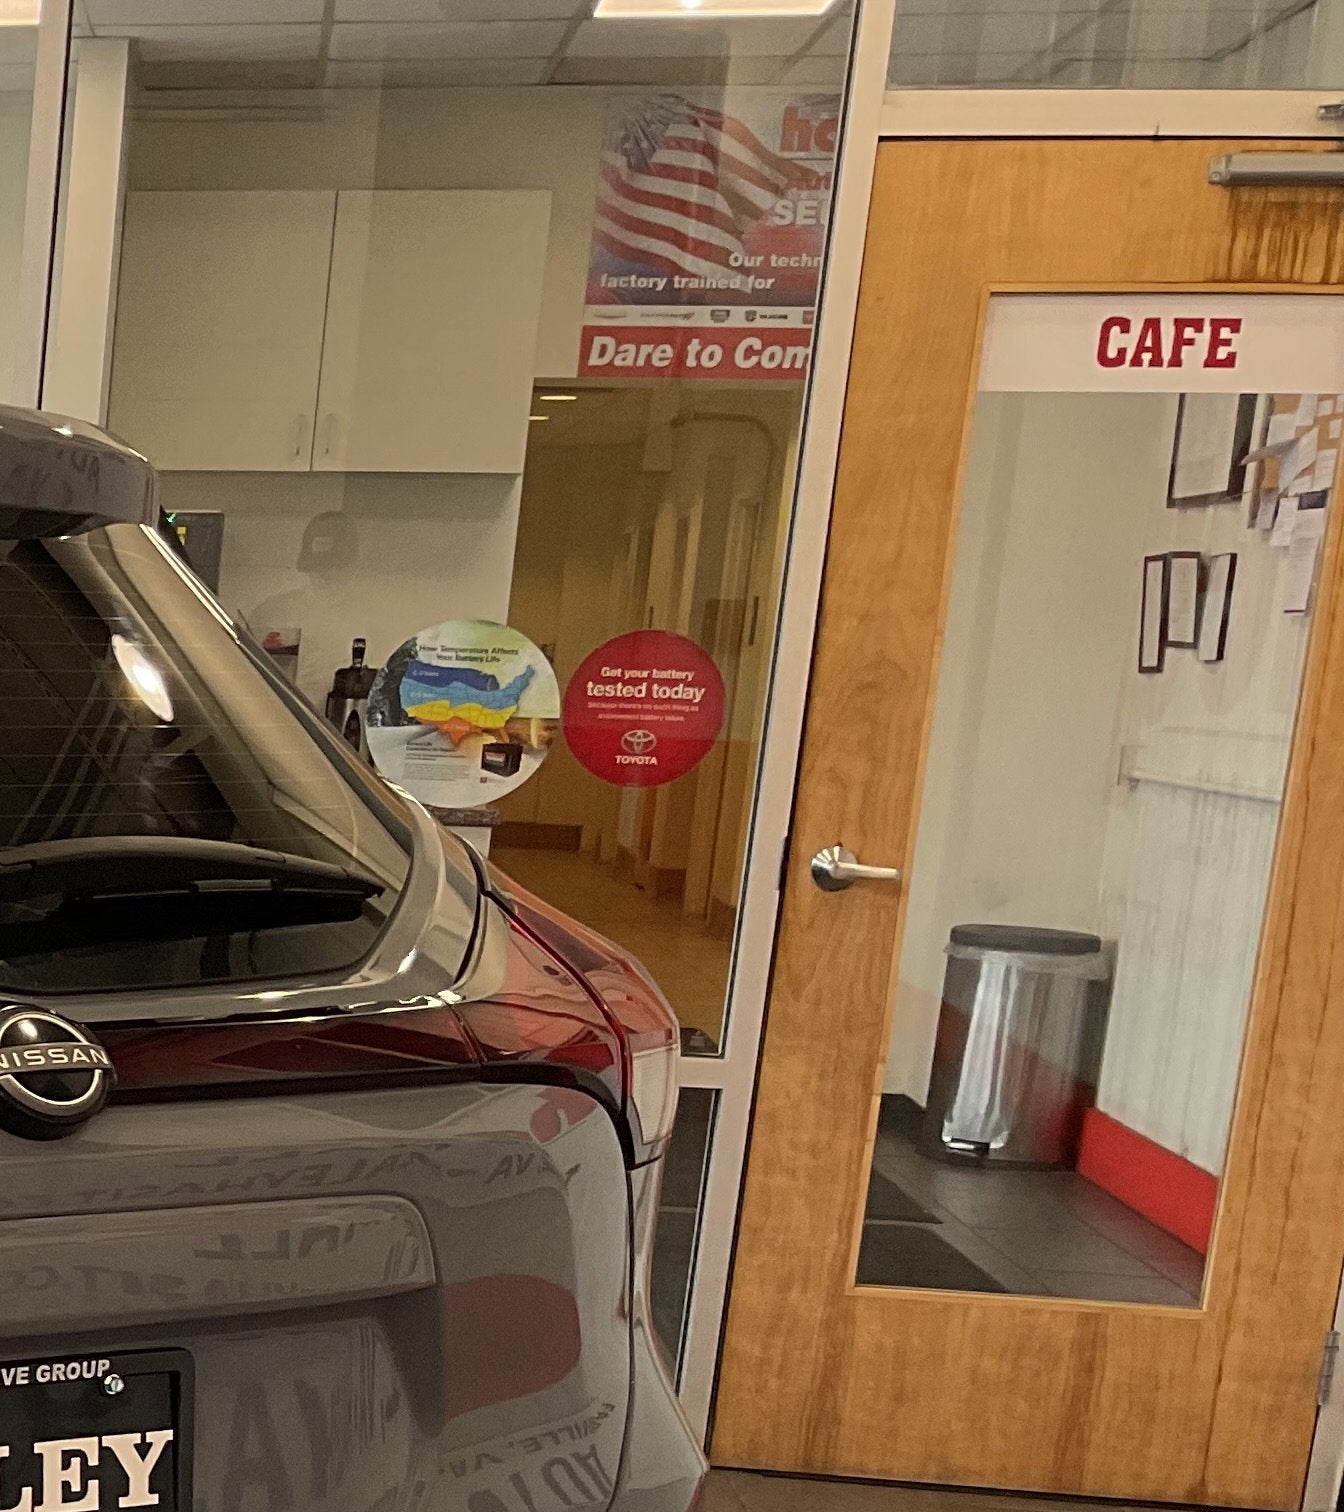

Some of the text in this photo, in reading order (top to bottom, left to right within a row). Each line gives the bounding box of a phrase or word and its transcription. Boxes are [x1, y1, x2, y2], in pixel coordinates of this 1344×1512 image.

[729, 252, 764, 267] Our
[601, 273, 775, 291] factory trained for
[1097, 316, 1242, 368] CAFE
[588, 336, 674, 367] Dare
[686, 338, 723, 369] to
[601, 666, 694, 681] Get your battery
[587, 681, 706, 703] tested today
[615, 755, 658, 766] TOYOTA
[35, 1358, 111, 1383] GROUP
